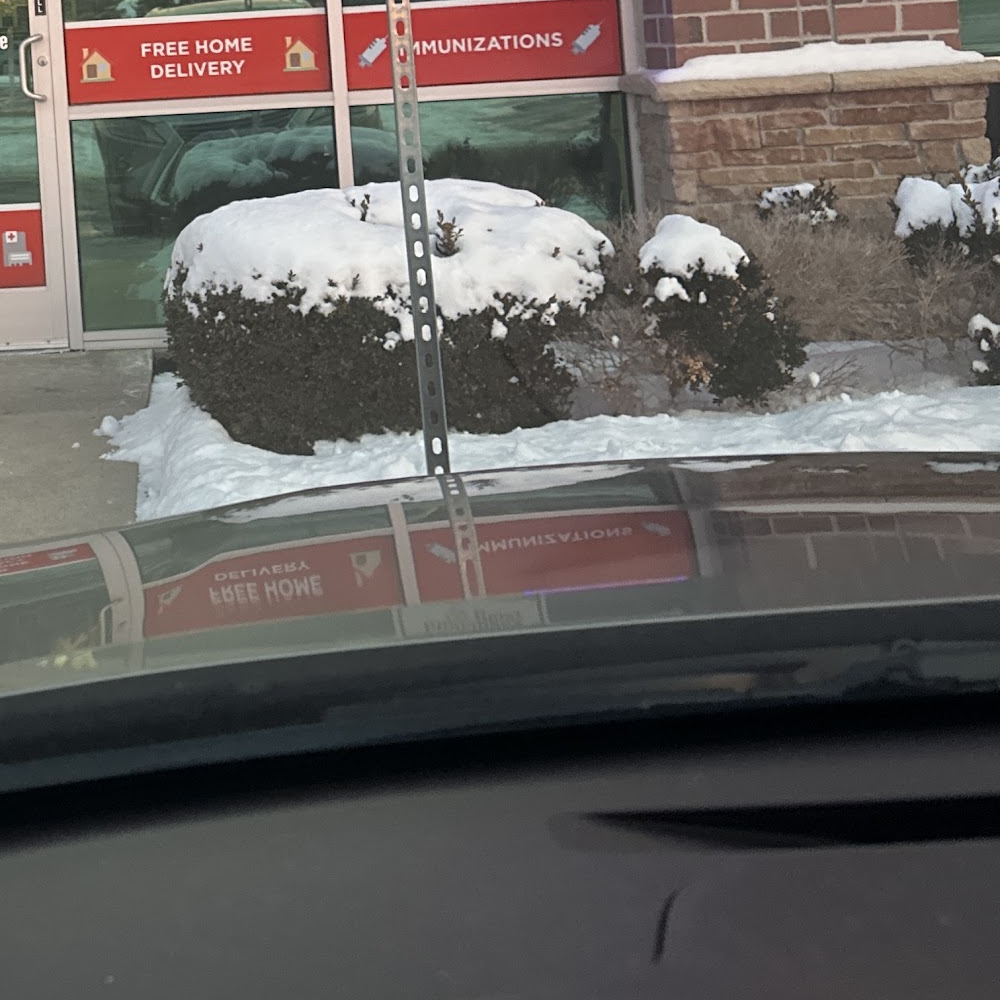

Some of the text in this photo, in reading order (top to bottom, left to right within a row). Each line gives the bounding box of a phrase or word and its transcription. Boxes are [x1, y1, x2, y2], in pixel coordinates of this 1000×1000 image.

[141, 36, 252, 57] FREE HOME
[150, 59, 245, 79] DELIVERY
